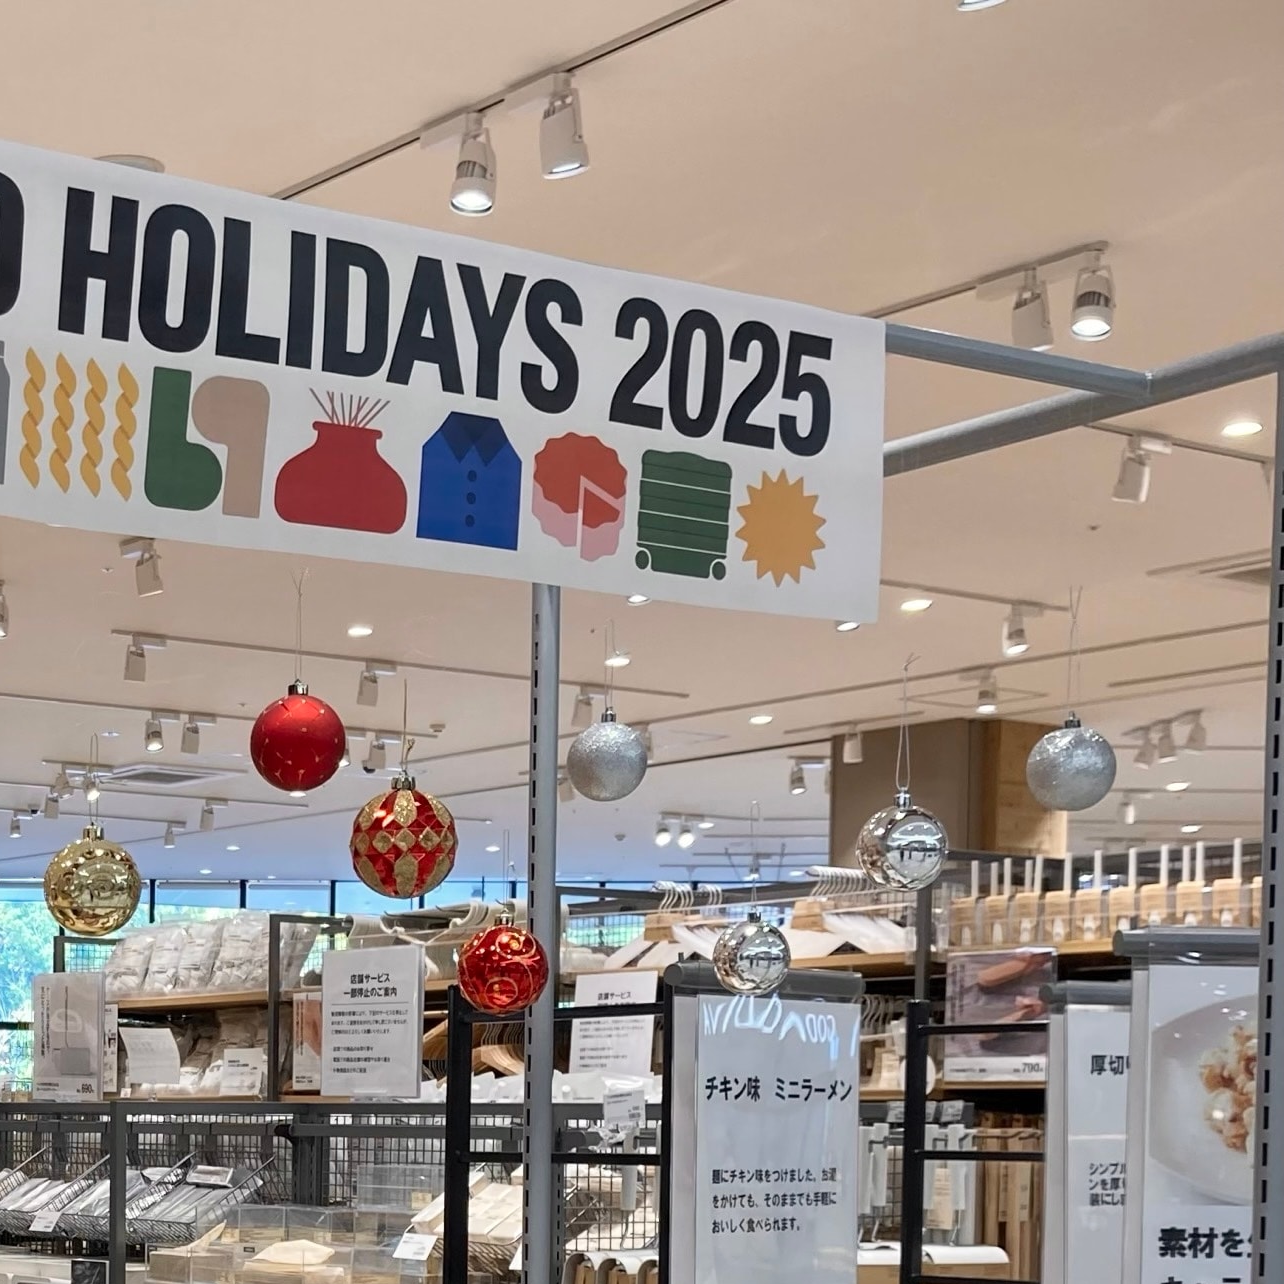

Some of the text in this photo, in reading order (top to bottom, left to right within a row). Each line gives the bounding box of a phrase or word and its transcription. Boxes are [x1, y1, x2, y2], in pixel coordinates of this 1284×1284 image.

[58, 186, 583, 415] HOLIDAYS
[609, 297, 834, 457] 2025
[705, 1076, 853, 1102] チキン味 ミニラーメン
